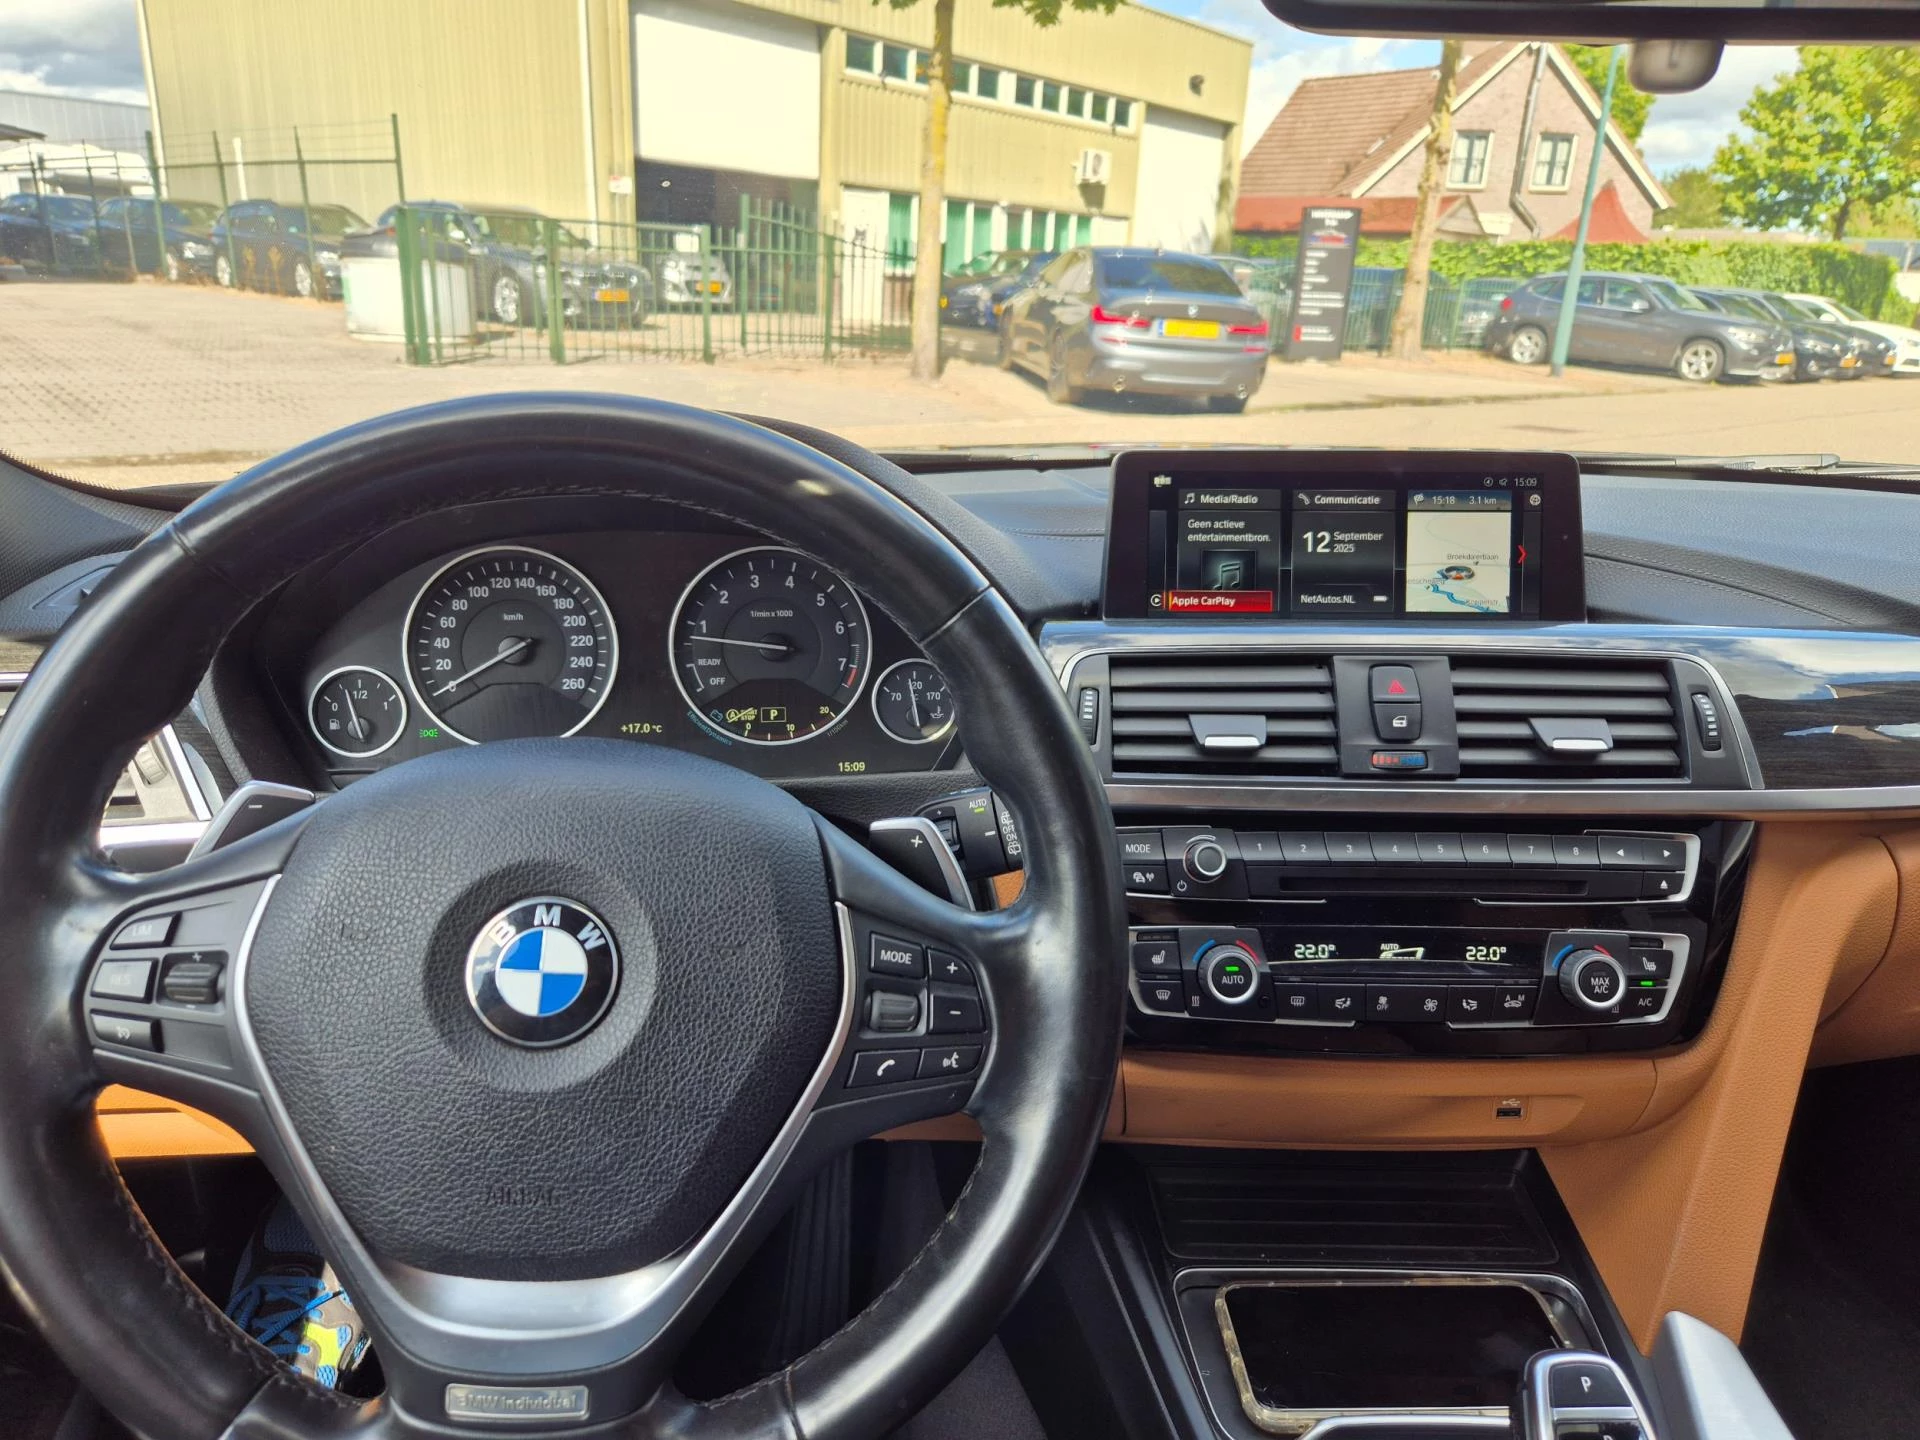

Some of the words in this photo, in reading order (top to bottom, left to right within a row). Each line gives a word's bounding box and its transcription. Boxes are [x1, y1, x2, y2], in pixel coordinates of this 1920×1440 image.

[1514, 478, 1537, 487] 15:09
[1200, 494, 1258, 505] Media/Radio
[1314, 495, 1381, 505] Communicatie
[1432, 496, 1456, 505] 15:18
[1469, 496, 1482, 505] 3.1
[1484, 496, 1497, 505] km
[1187, 519, 1212, 529] Geen
[1213, 519, 1245, 529] actieve
[1187, 533, 1271, 543] entertainmentbron.
[1303, 531, 1331, 553] 12
[1333, 531, 1384, 543] September
[1333, 543, 1355, 553] 2025
[490, 578, 511, 589] 120
[514, 577, 536, 589] 140
[750, 575, 760, 588] 3
[785, 576, 795, 589] 4
[468, 586, 489, 598] 100
[536, 585, 557, 597] 160
[719, 591, 729, 604] 2
[816, 594, 825, 607] 5
[1172, 596, 1199, 607] Apple
[1201, 596, 1236, 607] CarPlay
[1300, 594, 1356, 605] NetAutos.NL
[451, 600, 468, 611] 80
[553, 598, 574, 610] 180
[503, 612, 524, 622] km/h
[777, 610, 793, 618] 1000
[440, 617, 456, 628] 60
[563, 616, 587, 627] 200
[700, 620, 707, 633] 1
[835, 621, 845, 635] 6
[433, 637, 450, 649] 40
[570, 635, 594, 647] 220
[435, 658, 452, 670] 20
[570, 656, 594, 668] 240
[698, 658, 721, 667] READY
[838, 658, 847, 672] 7
[561, 678, 585, 690] 260
[710, 677, 726, 686] OFF
[908, 681, 923, 690] 20
[353, 689, 368, 700] 1/2
[891, 692, 902, 701] 70
[926, 692, 941, 700] 170
[331, 702, 338, 712] 0
[383, 701, 388, 711] 1
[819, 706, 829, 714] 20
[770, 709, 778, 721] P
[786, 723, 795, 731] 10
[838, 761, 865, 772] 15:09
[969, 798, 987, 809] AUTO
[1003, 824, 1015, 834] OFF
[1006, 833, 1018, 842] ON
[1125, 843, 1151, 853] MODE
[1257, 842, 1262, 852] 1
[1301, 843, 1306, 853] 2
[1346, 844, 1352, 853] 3
[1391, 844, 1398, 854] 4
[1437, 845, 1443, 854] 5
[1482, 845, 1489, 854] 6
[1528, 846, 1534, 855] 7
[1573, 846, 1579, 856] 8
[488, 904, 606, 950] BMW
[880, 949, 912, 965] MODE
[1221, 975, 1244, 985] AUTO
[1590, 976, 1610, 987] MAX
[1594, 985, 1609, 995] A/C
[1376, 1003, 1388, 1011] OFF
[1638, 998, 1652, 1007] A/C
[1580, 1376, 1592, 1392] P
